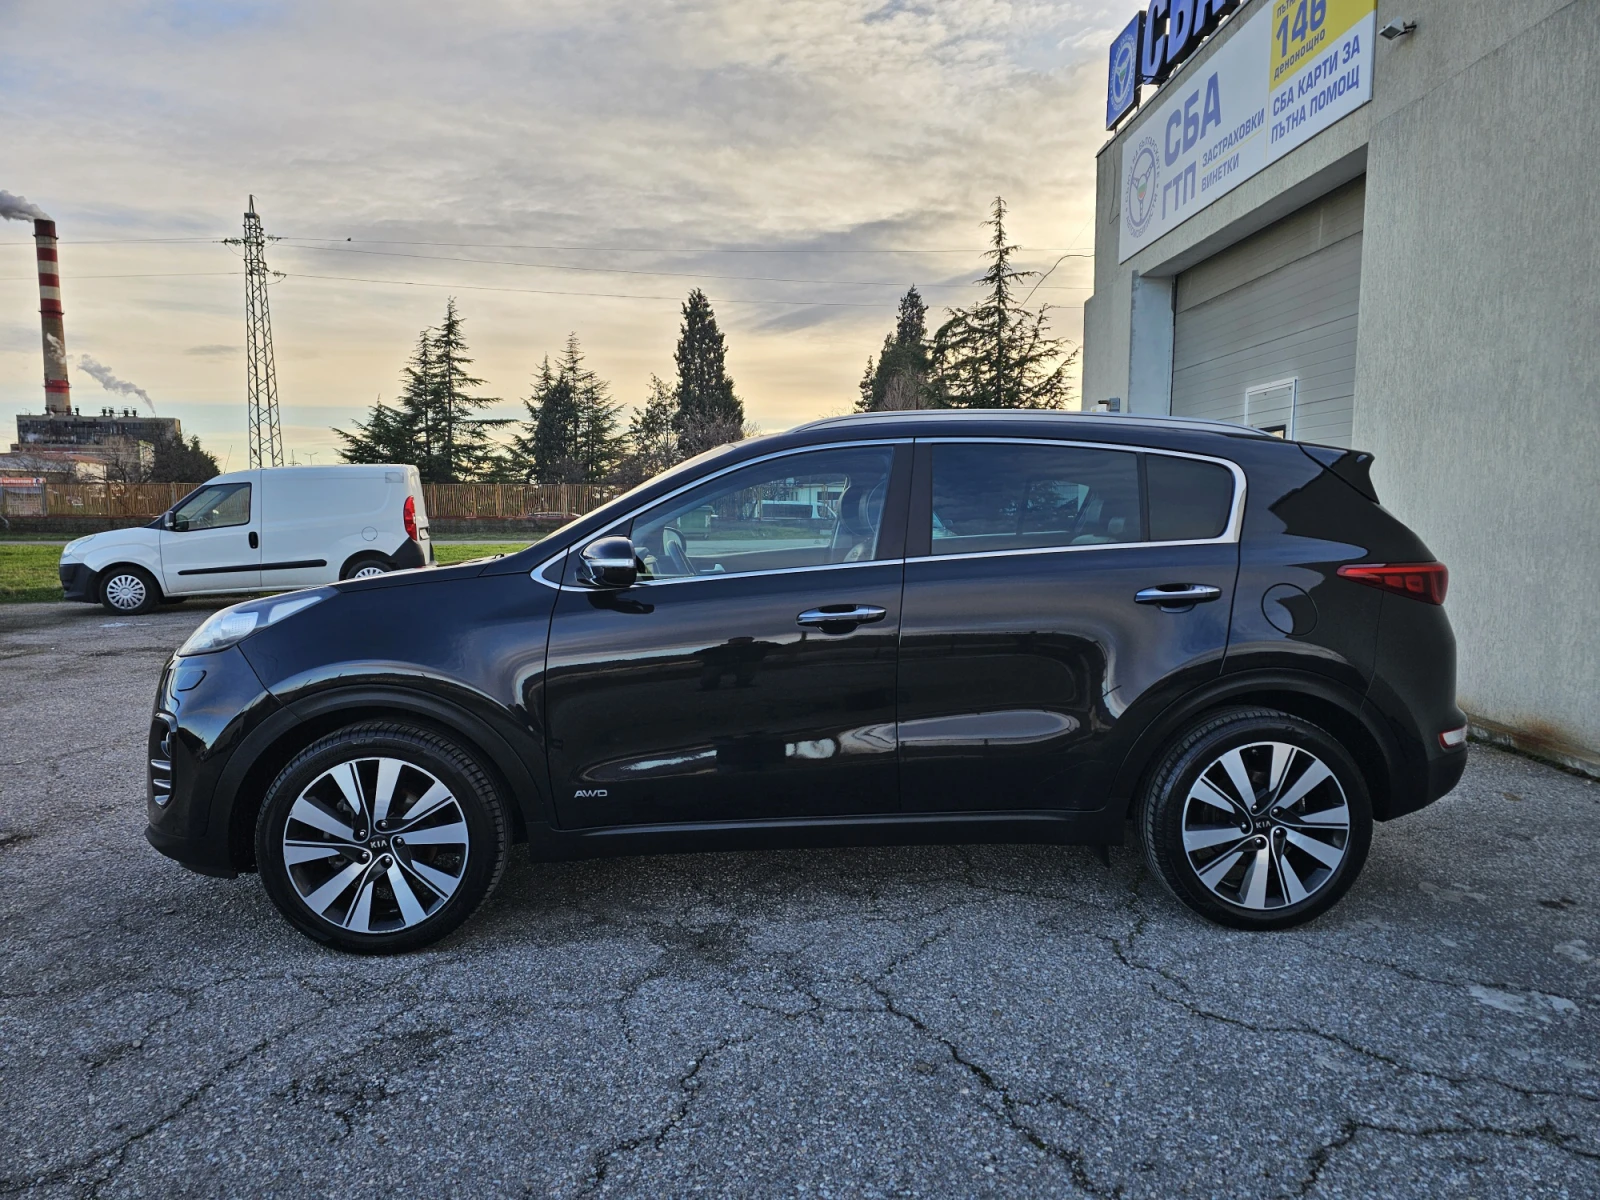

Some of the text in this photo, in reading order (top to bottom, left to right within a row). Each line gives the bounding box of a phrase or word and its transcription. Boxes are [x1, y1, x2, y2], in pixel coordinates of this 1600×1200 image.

[1274, 29, 1326, 81] денонощно
[1276, 0, 1327, 58] 146
[1271, 64, 1360, 144] ПЪТНА ПОМОЩ
[1273, 34, 1360, 116] СБА КАРТИ ЗА
[1164, 71, 1221, 167] СБА
[1202, 107, 1265, 167] ЗАСТРАХОВКИ
[1162, 160, 1196, 221] ГТП
[1201, 152, 1240, 193] ВИНЕТКИ
[574, 789, 608, 798] AWD
[370, 840, 388, 849] KIA
